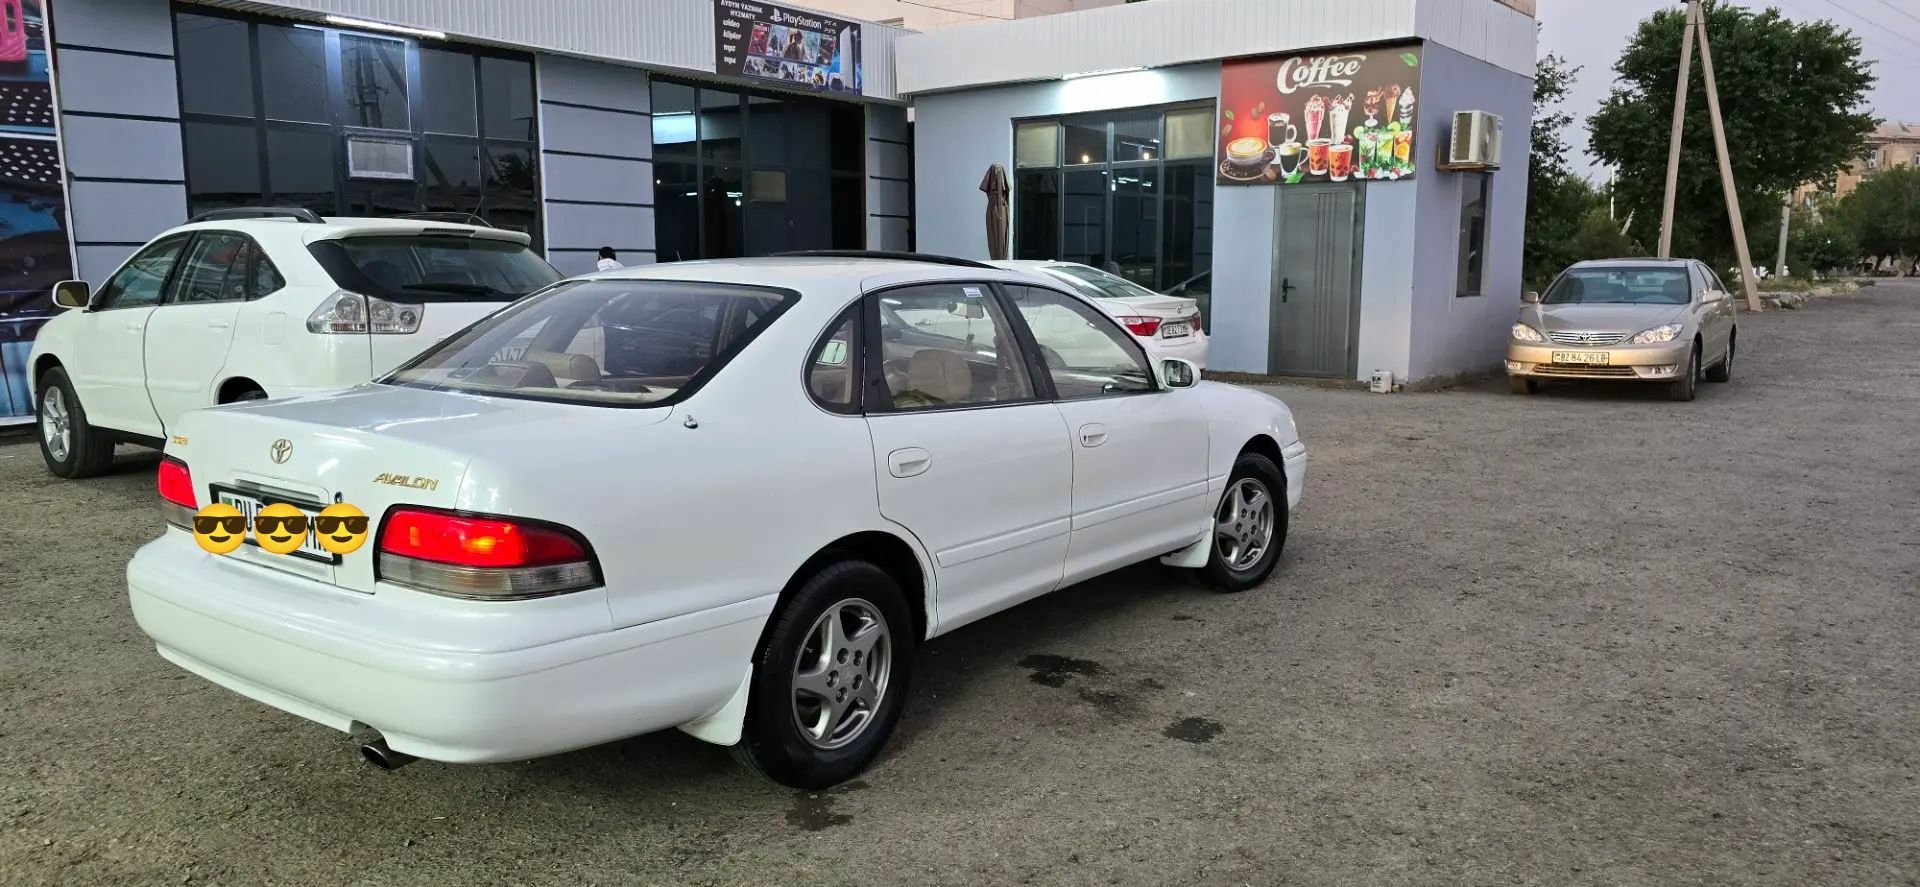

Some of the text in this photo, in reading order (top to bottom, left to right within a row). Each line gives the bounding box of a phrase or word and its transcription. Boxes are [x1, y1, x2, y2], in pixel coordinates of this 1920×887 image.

[782, 12, 822, 30] PlayStation
[1277, 54, 1367, 94] Coffee
[1583, 353, 1595, 363] 26
[371, 472, 440, 491] AVALON
